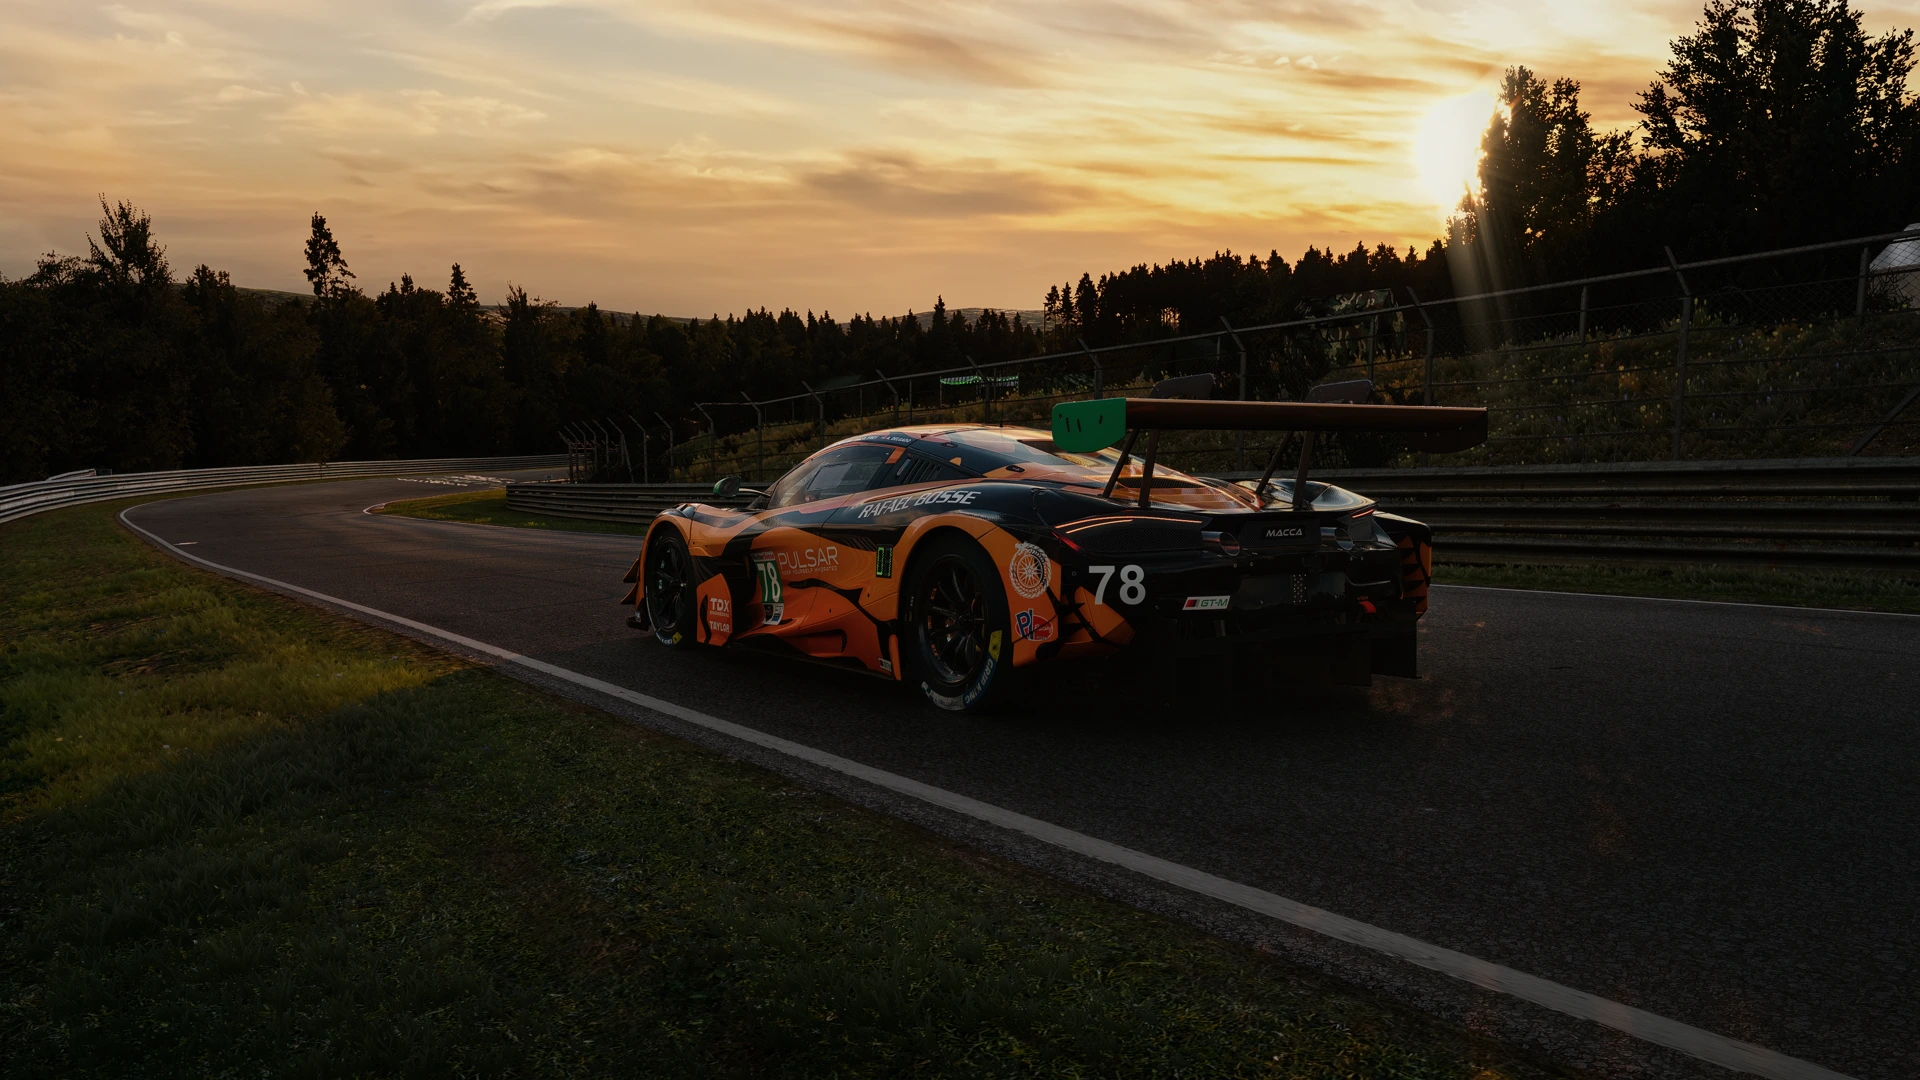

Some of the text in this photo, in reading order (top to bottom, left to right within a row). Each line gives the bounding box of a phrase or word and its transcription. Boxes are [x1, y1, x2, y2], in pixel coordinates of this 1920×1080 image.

[857, 490, 981, 519] RAFAEL BOSSE
[1266, 528, 1303, 537] MACCA
[777, 546, 839, 570] PULSAR
[757, 562, 780, 602] 78
[1088, 564, 1146, 605] 78
[710, 597, 730, 613] TDX
[1200, 598, 1228, 607] GT-M
[709, 620, 730, 632] TAYLOR
[965, 658, 993, 704] GRIP KING
